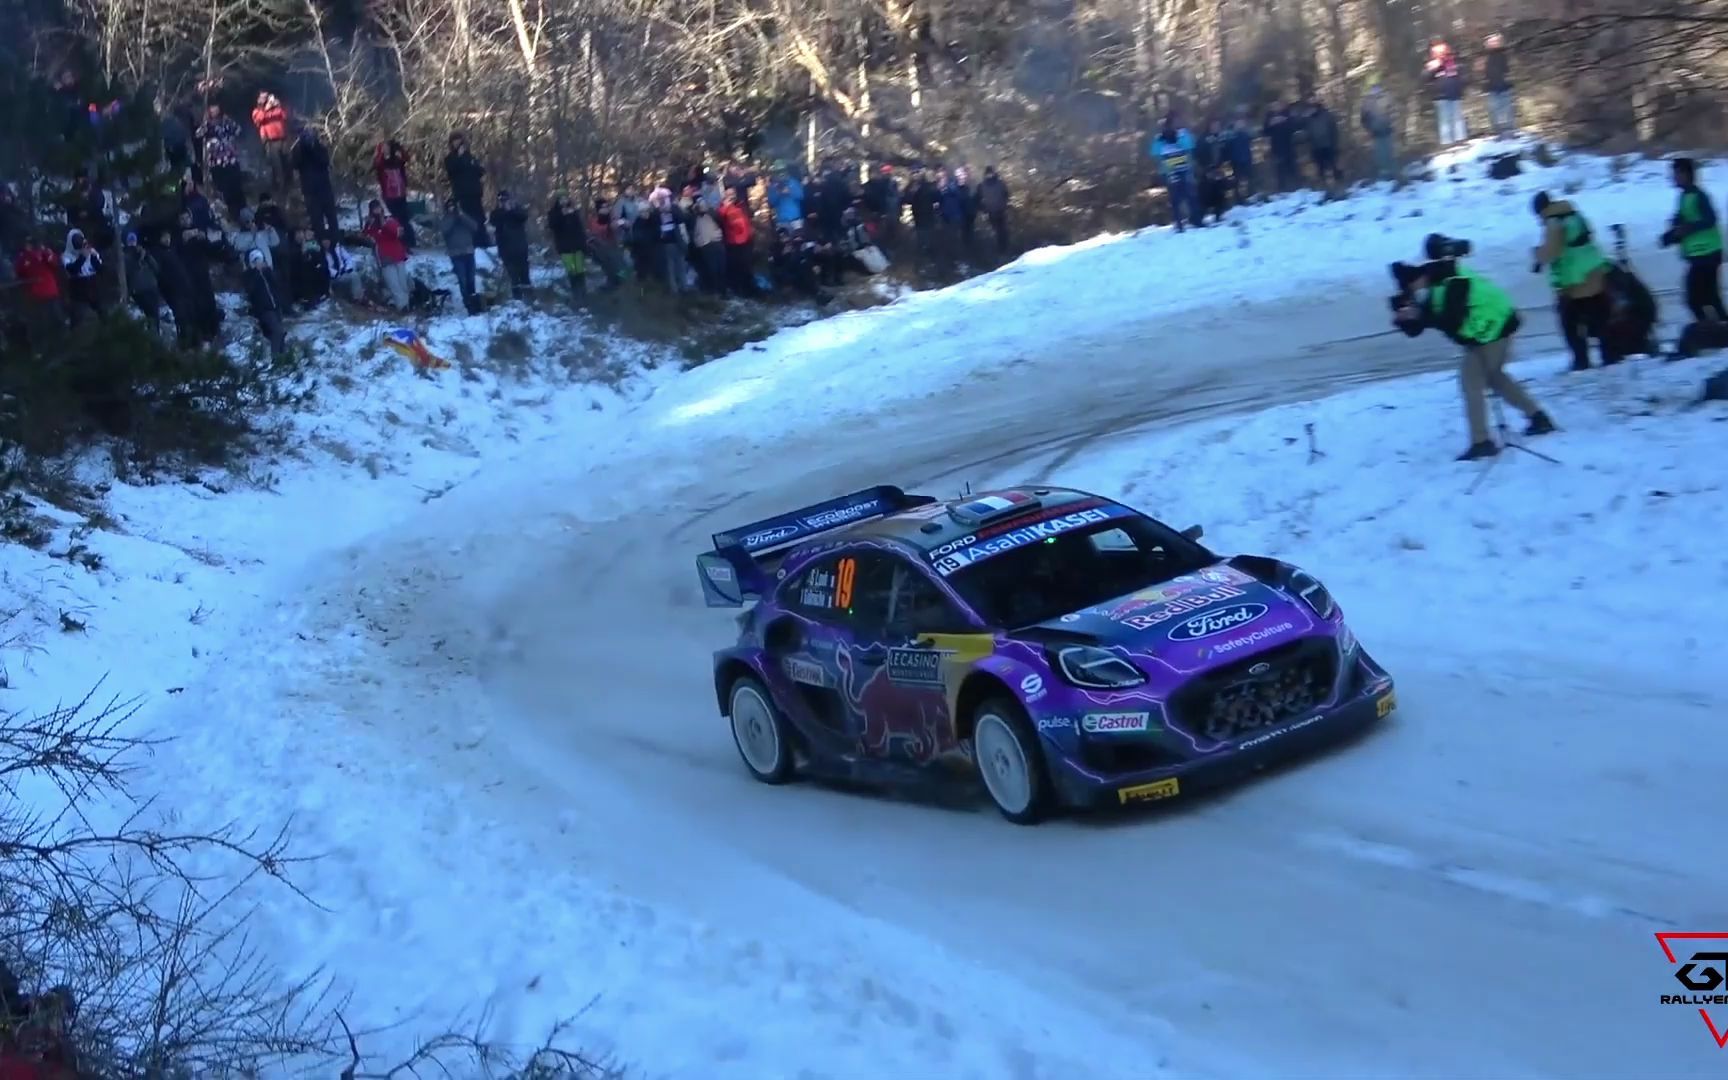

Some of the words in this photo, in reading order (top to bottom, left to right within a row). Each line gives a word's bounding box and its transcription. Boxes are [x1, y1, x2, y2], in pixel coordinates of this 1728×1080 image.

[928, 535, 977, 560] FORD
[935, 555, 961, 573] 19
[835, 558, 855, 608] 19
[1187, 607, 1253, 637] Ford
[1213, 621, 1293, 654] SafetyCulture
[1038, 715, 1071, 731] pulse
[1098, 715, 1144, 730] Castrol
